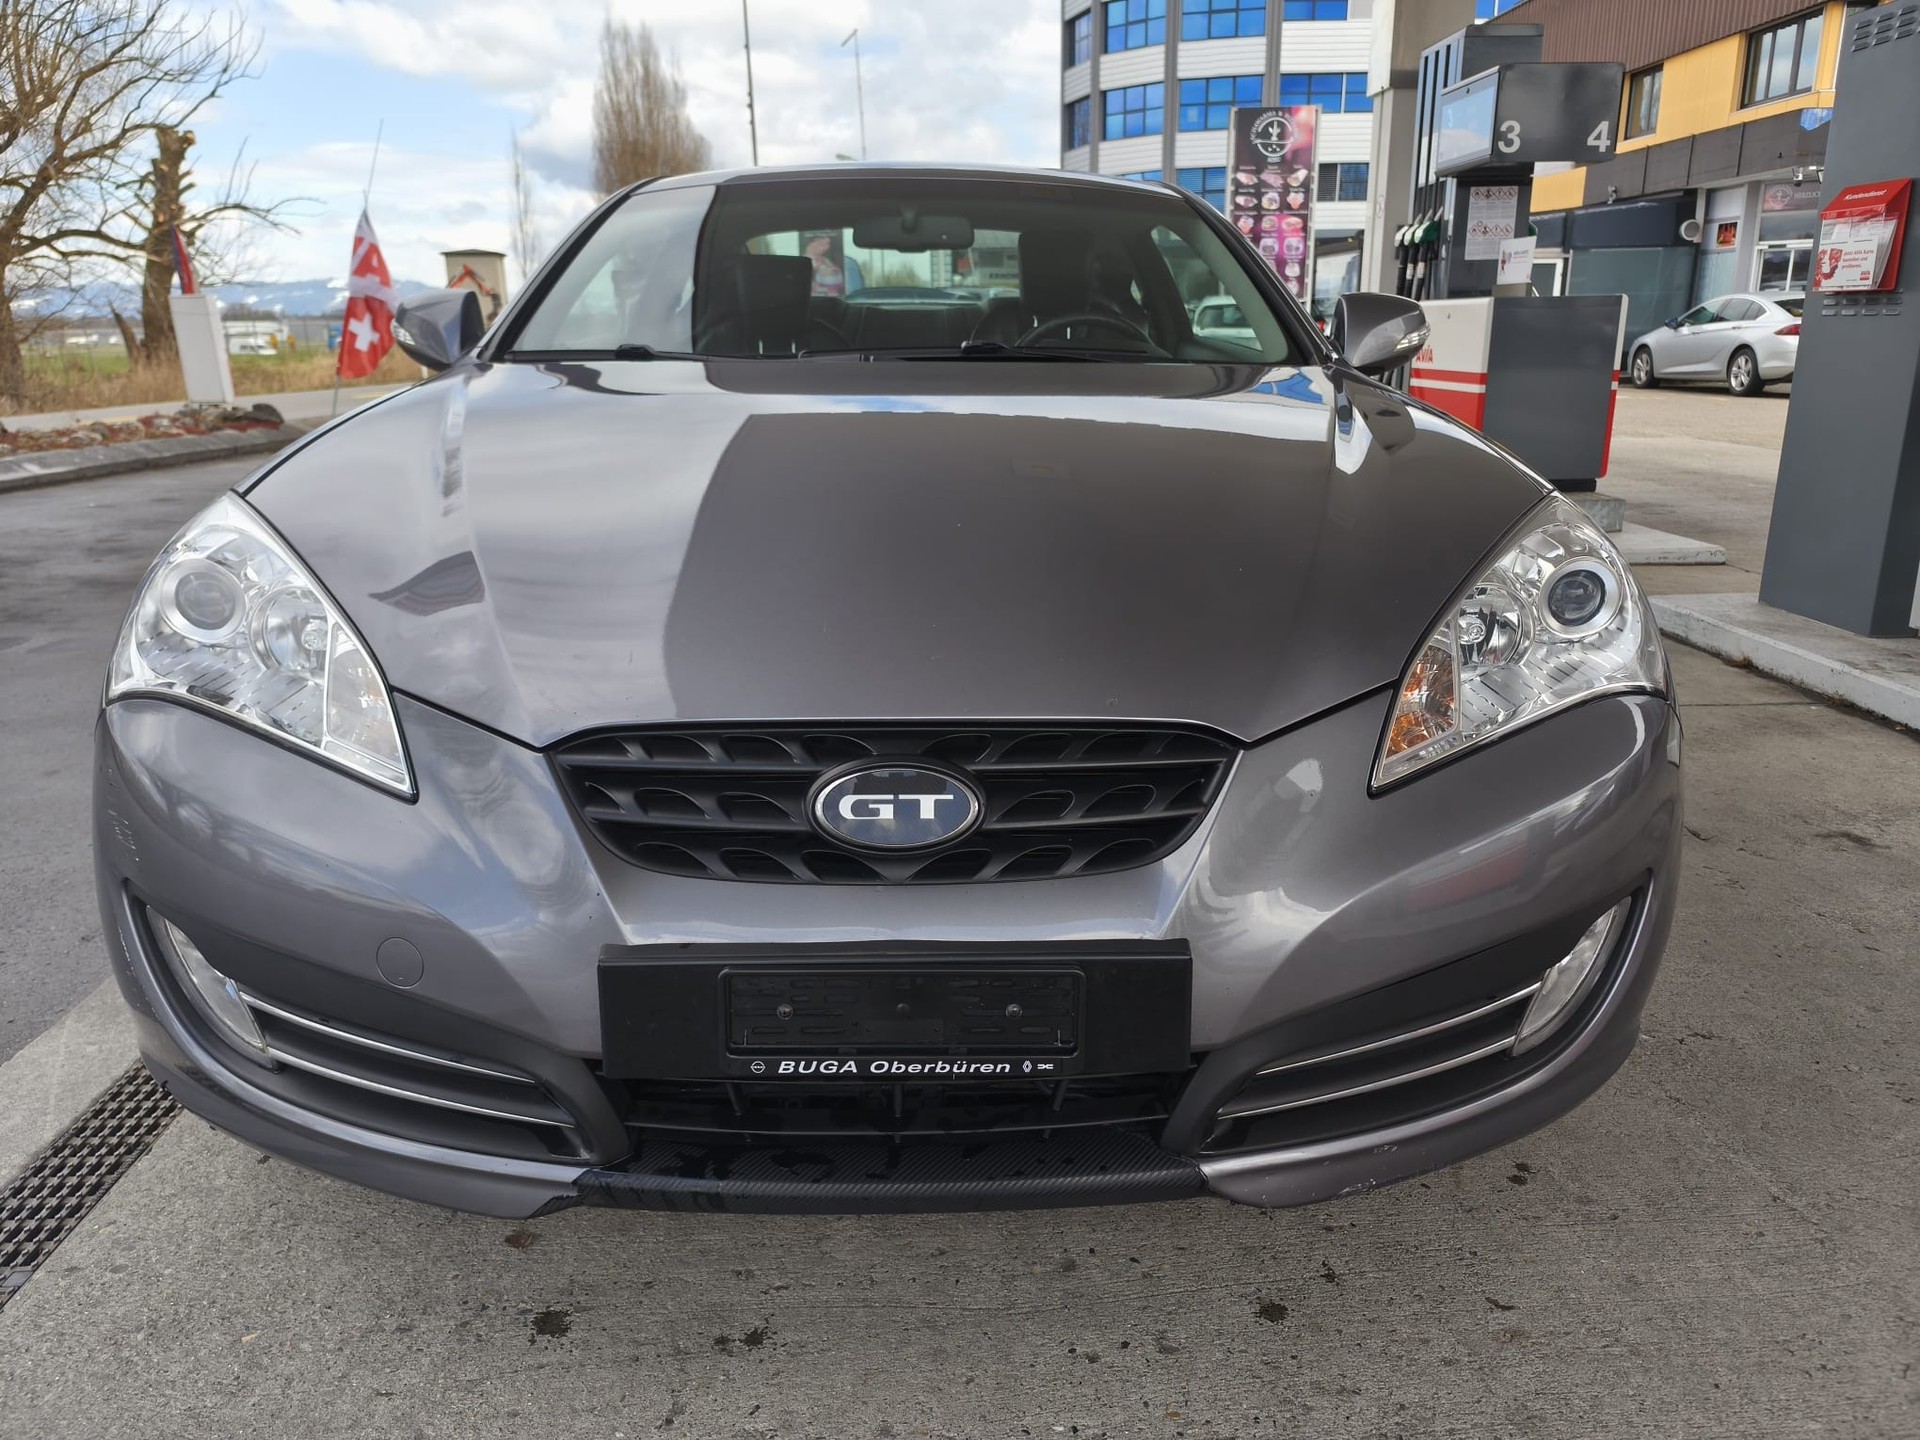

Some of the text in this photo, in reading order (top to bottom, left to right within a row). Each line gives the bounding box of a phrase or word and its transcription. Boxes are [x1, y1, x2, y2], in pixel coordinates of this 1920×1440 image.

[1498, 120, 1611, 153] 3 4
[839, 794, 954, 820] GT
[778, 1060, 1011, 1074] BUGA Oberbüren
